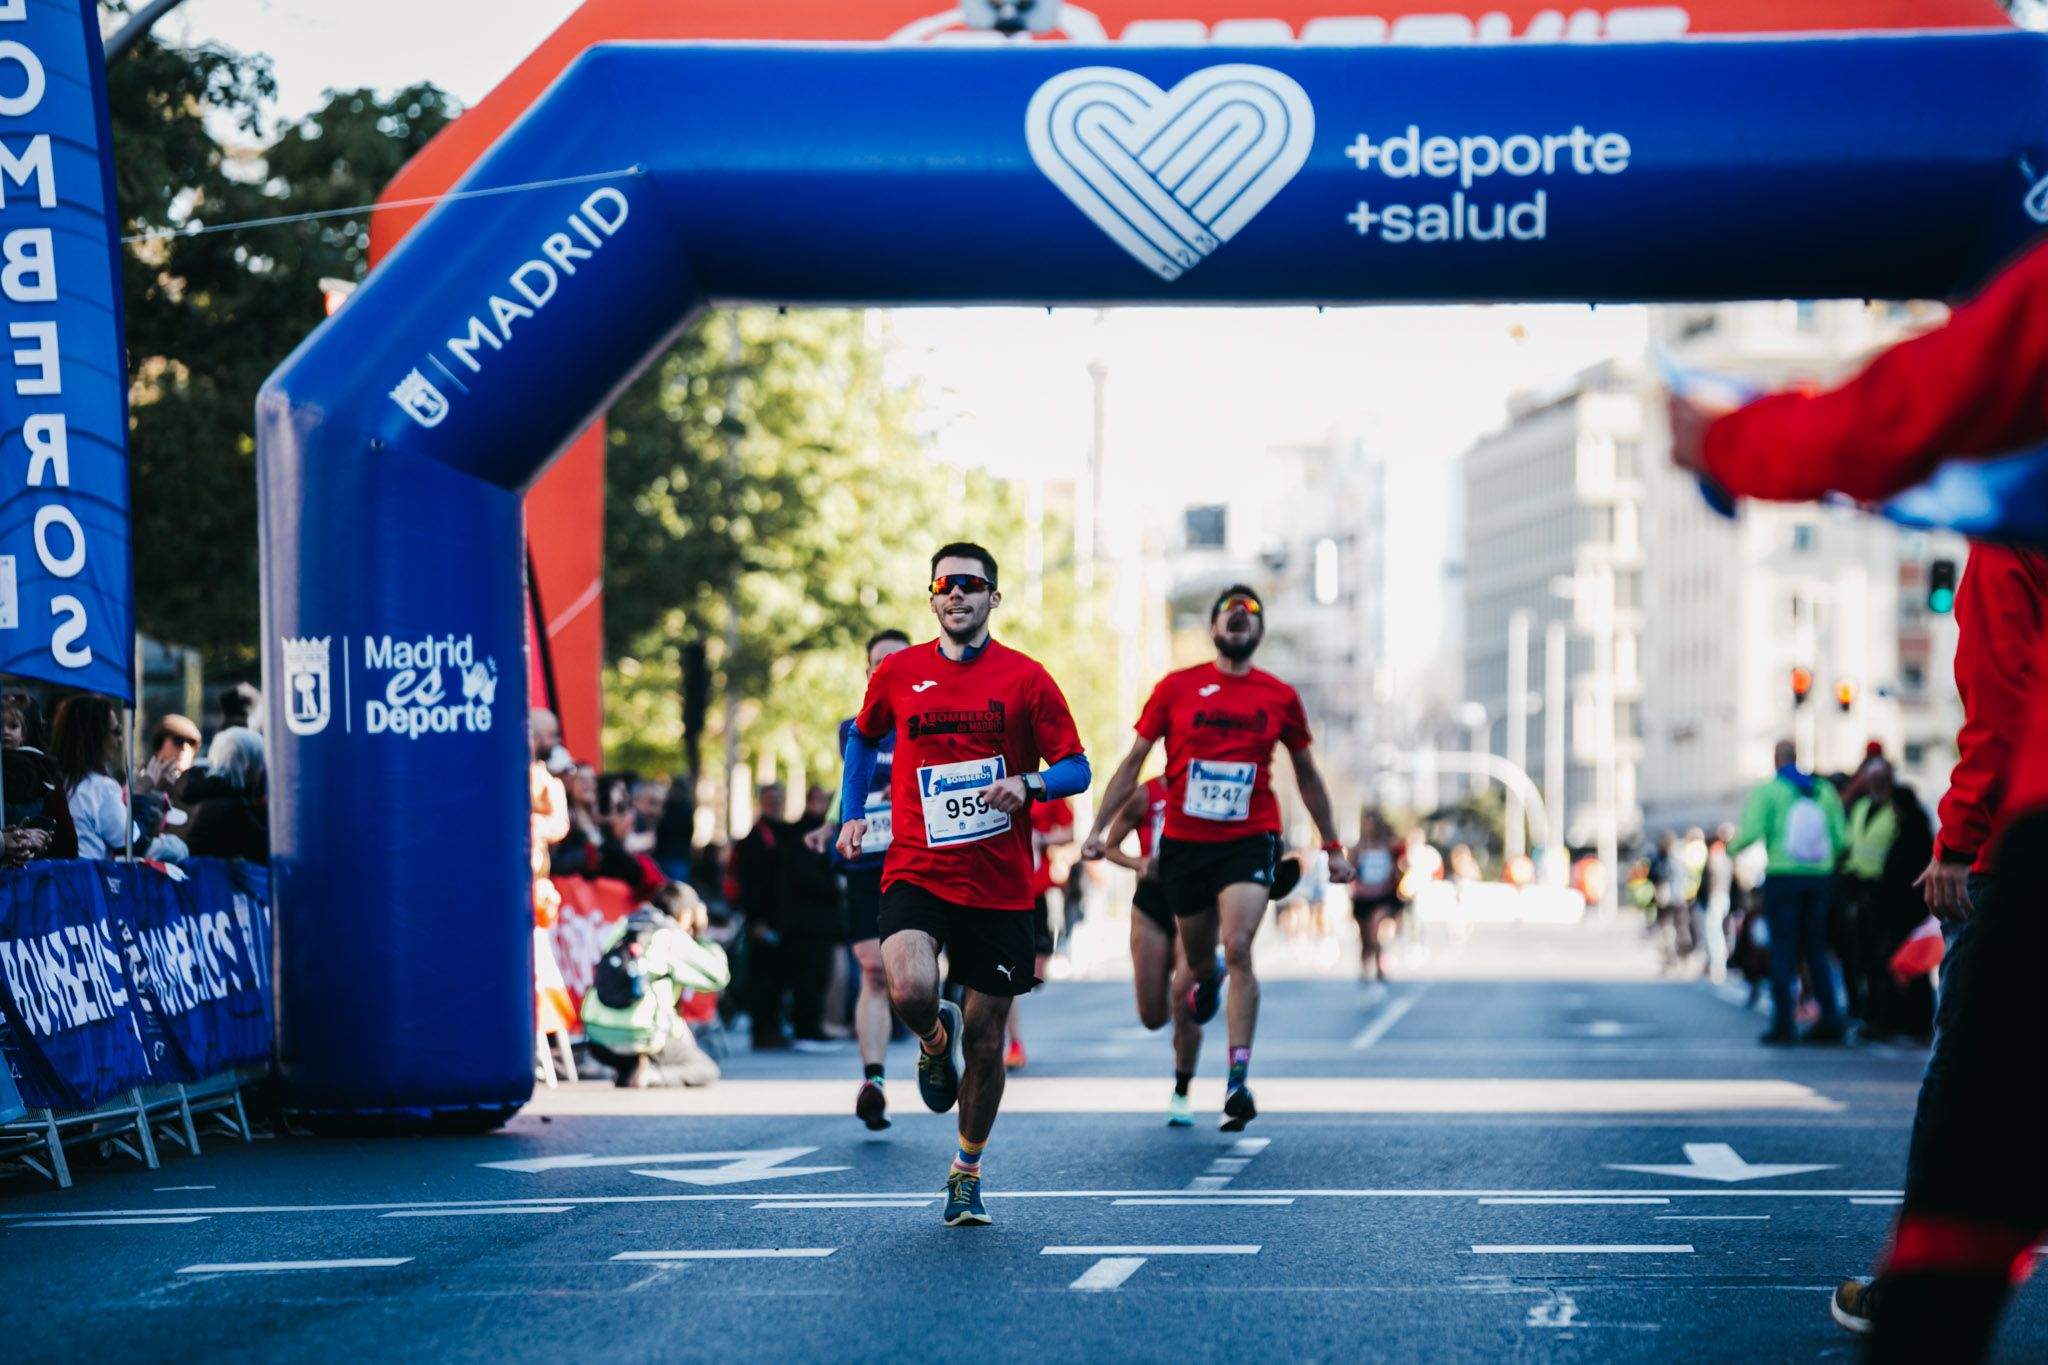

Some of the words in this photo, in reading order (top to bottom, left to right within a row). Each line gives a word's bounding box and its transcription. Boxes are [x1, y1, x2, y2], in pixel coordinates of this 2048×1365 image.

[1344, 124, 1631, 189] +deporte
[1346, 189, 1547, 242] +salud
[446, 187, 629, 373] MADRID
[365, 633, 473, 669] Madrid
[386, 667, 447, 706] es
[365, 698, 492, 740] Deporte
[928, 711, 1002, 723] BOMBEROS
[946, 771, 991, 784] BOMBEROS
[1202, 784, 1242, 803] 1247
